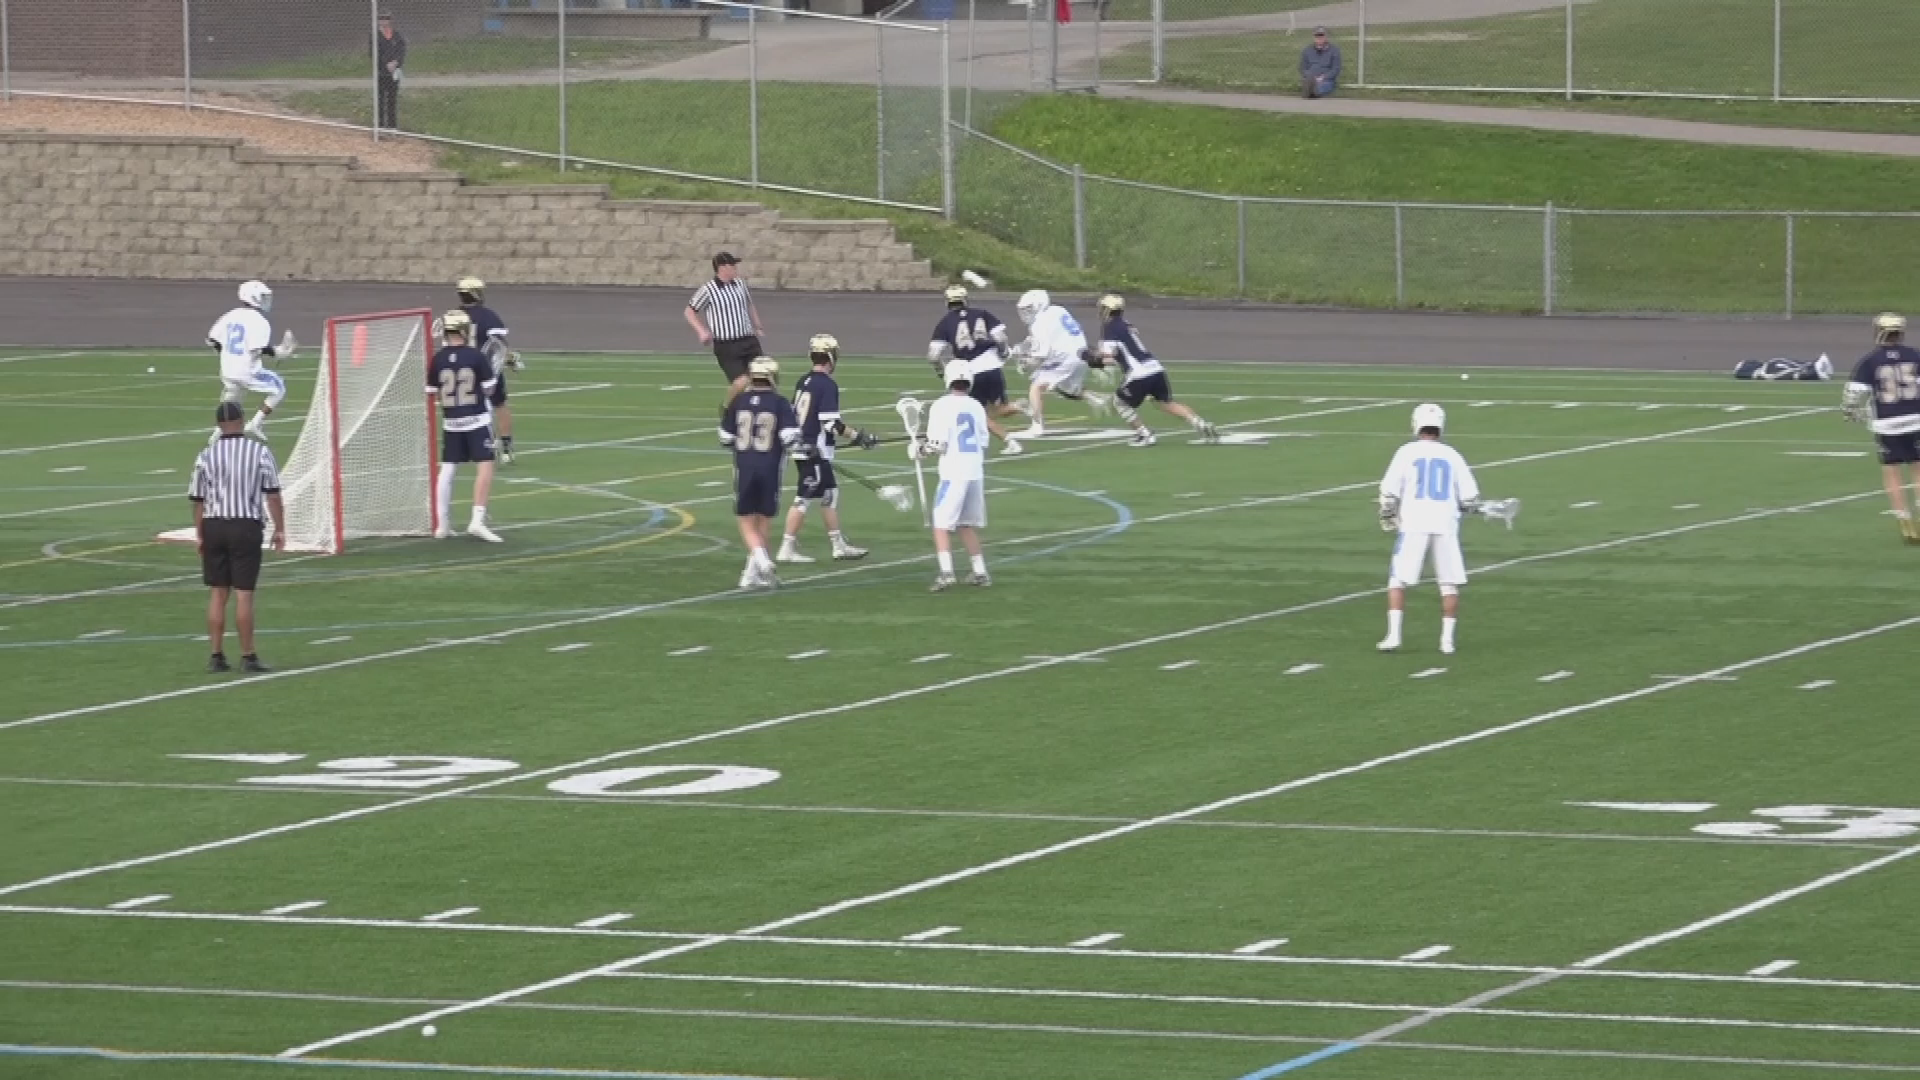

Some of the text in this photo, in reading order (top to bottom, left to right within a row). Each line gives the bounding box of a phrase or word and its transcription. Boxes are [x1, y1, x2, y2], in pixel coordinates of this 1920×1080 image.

[226, 323, 246, 355] 12
[438, 368, 477, 407] 22
[735, 410, 778, 453] 33
[956, 412, 978, 453] 2
[1412, 458, 1453, 501] 10
